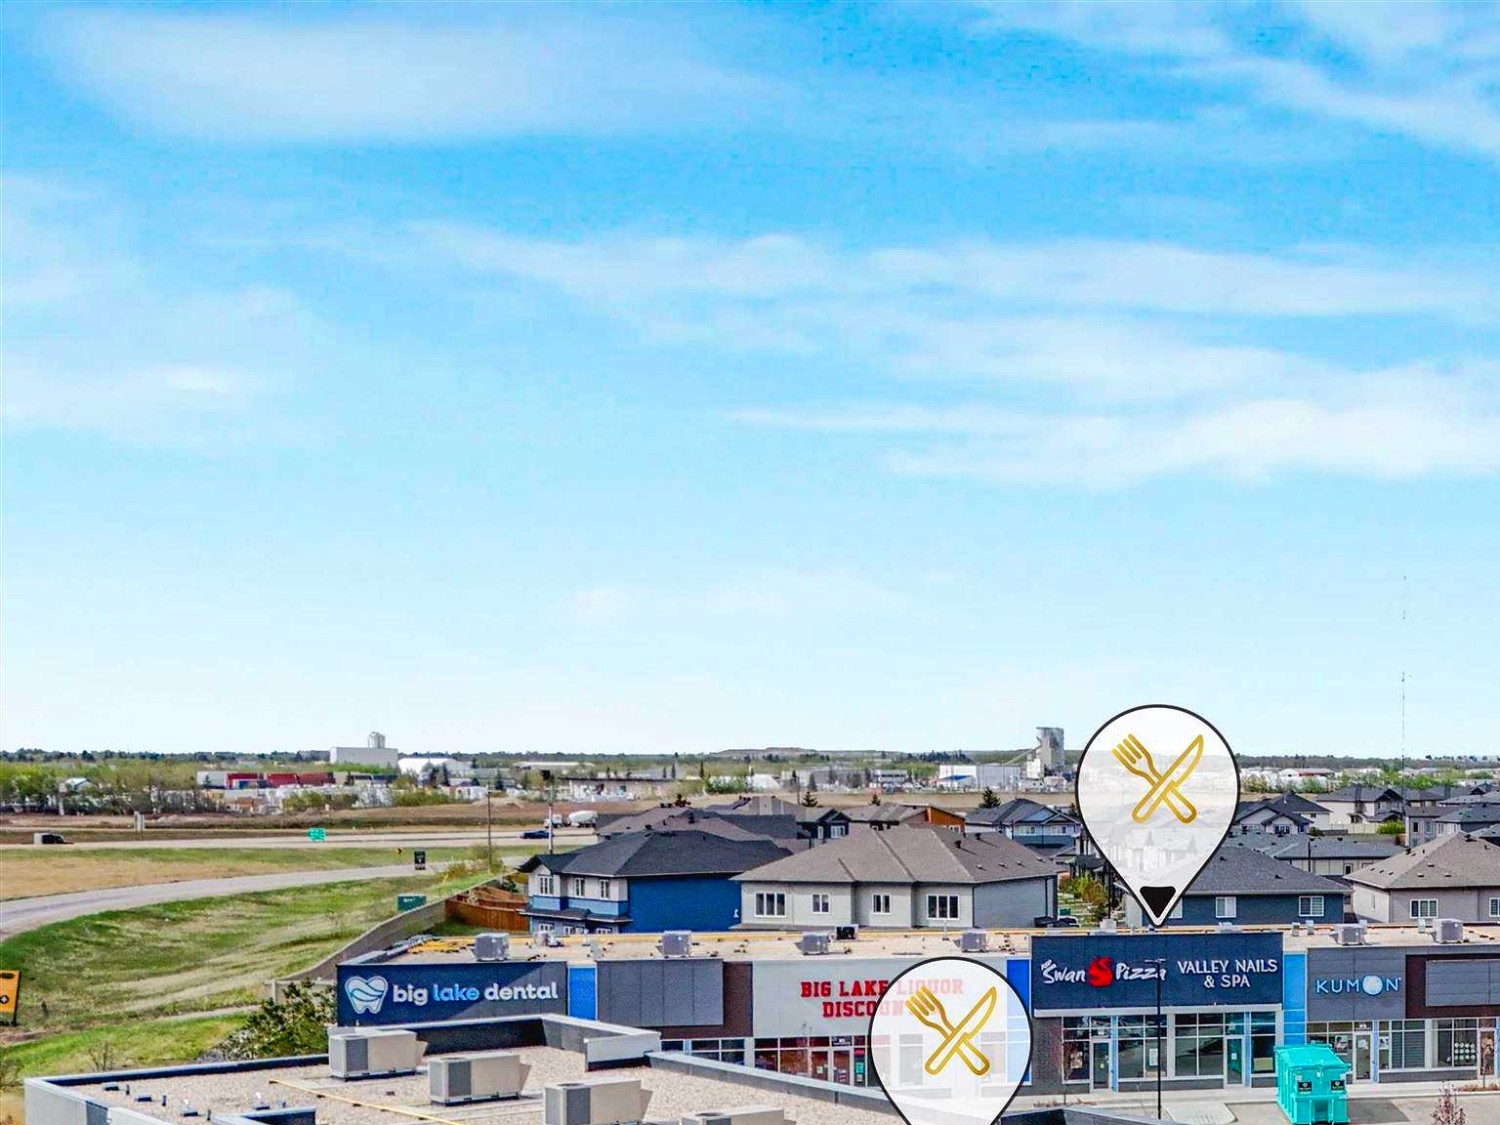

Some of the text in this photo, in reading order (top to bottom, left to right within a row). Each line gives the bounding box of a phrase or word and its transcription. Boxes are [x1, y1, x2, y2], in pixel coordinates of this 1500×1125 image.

[1043, 963, 1086, 984] Swan
[1177, 958, 1278, 974] VALLEY NAILS
[801, 981, 832, 998] BIG
[839, 979, 889, 997] LAKE
[1203, 974, 1251, 989] & SPA
[1316, 974, 1399, 996] KUMON
[393, 980, 559, 1007] big lake dental
